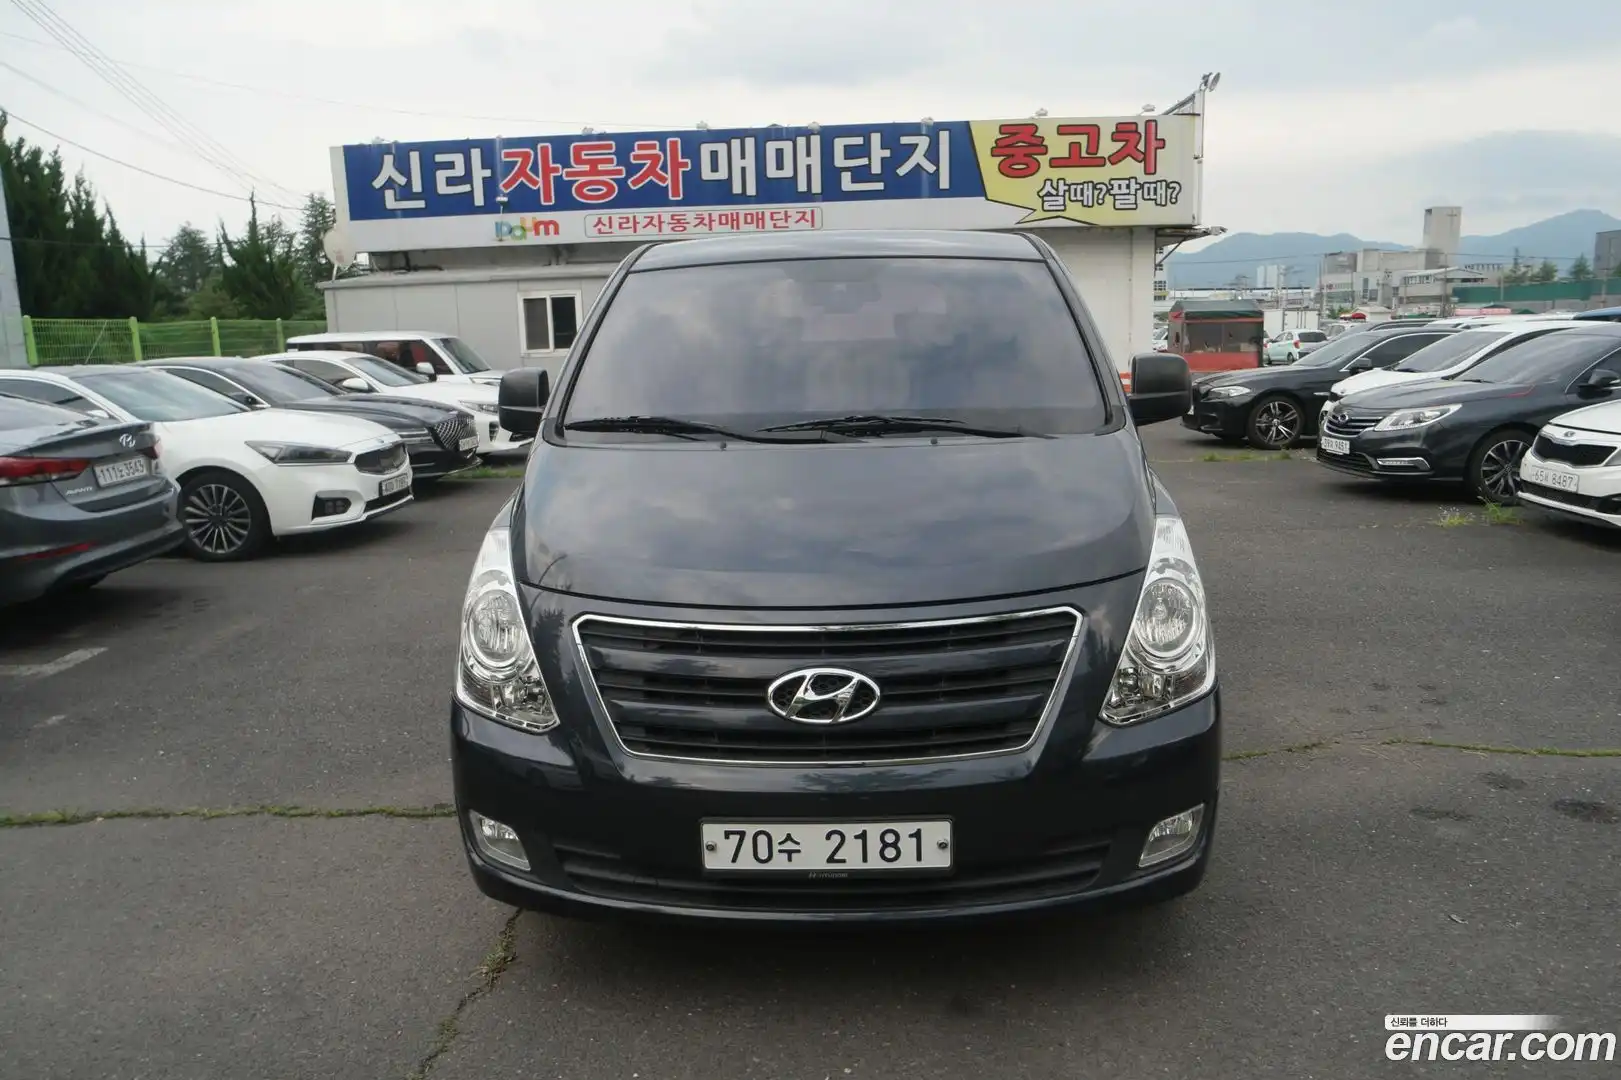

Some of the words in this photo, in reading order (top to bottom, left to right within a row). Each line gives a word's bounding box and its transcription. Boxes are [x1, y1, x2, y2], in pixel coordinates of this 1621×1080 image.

[991, 119, 1165, 179] 중고차
[592, 208, 816, 235] 신라자동차매매단지
[723, 829, 802, 864] 70수
[825, 828, 924, 864] 2181
